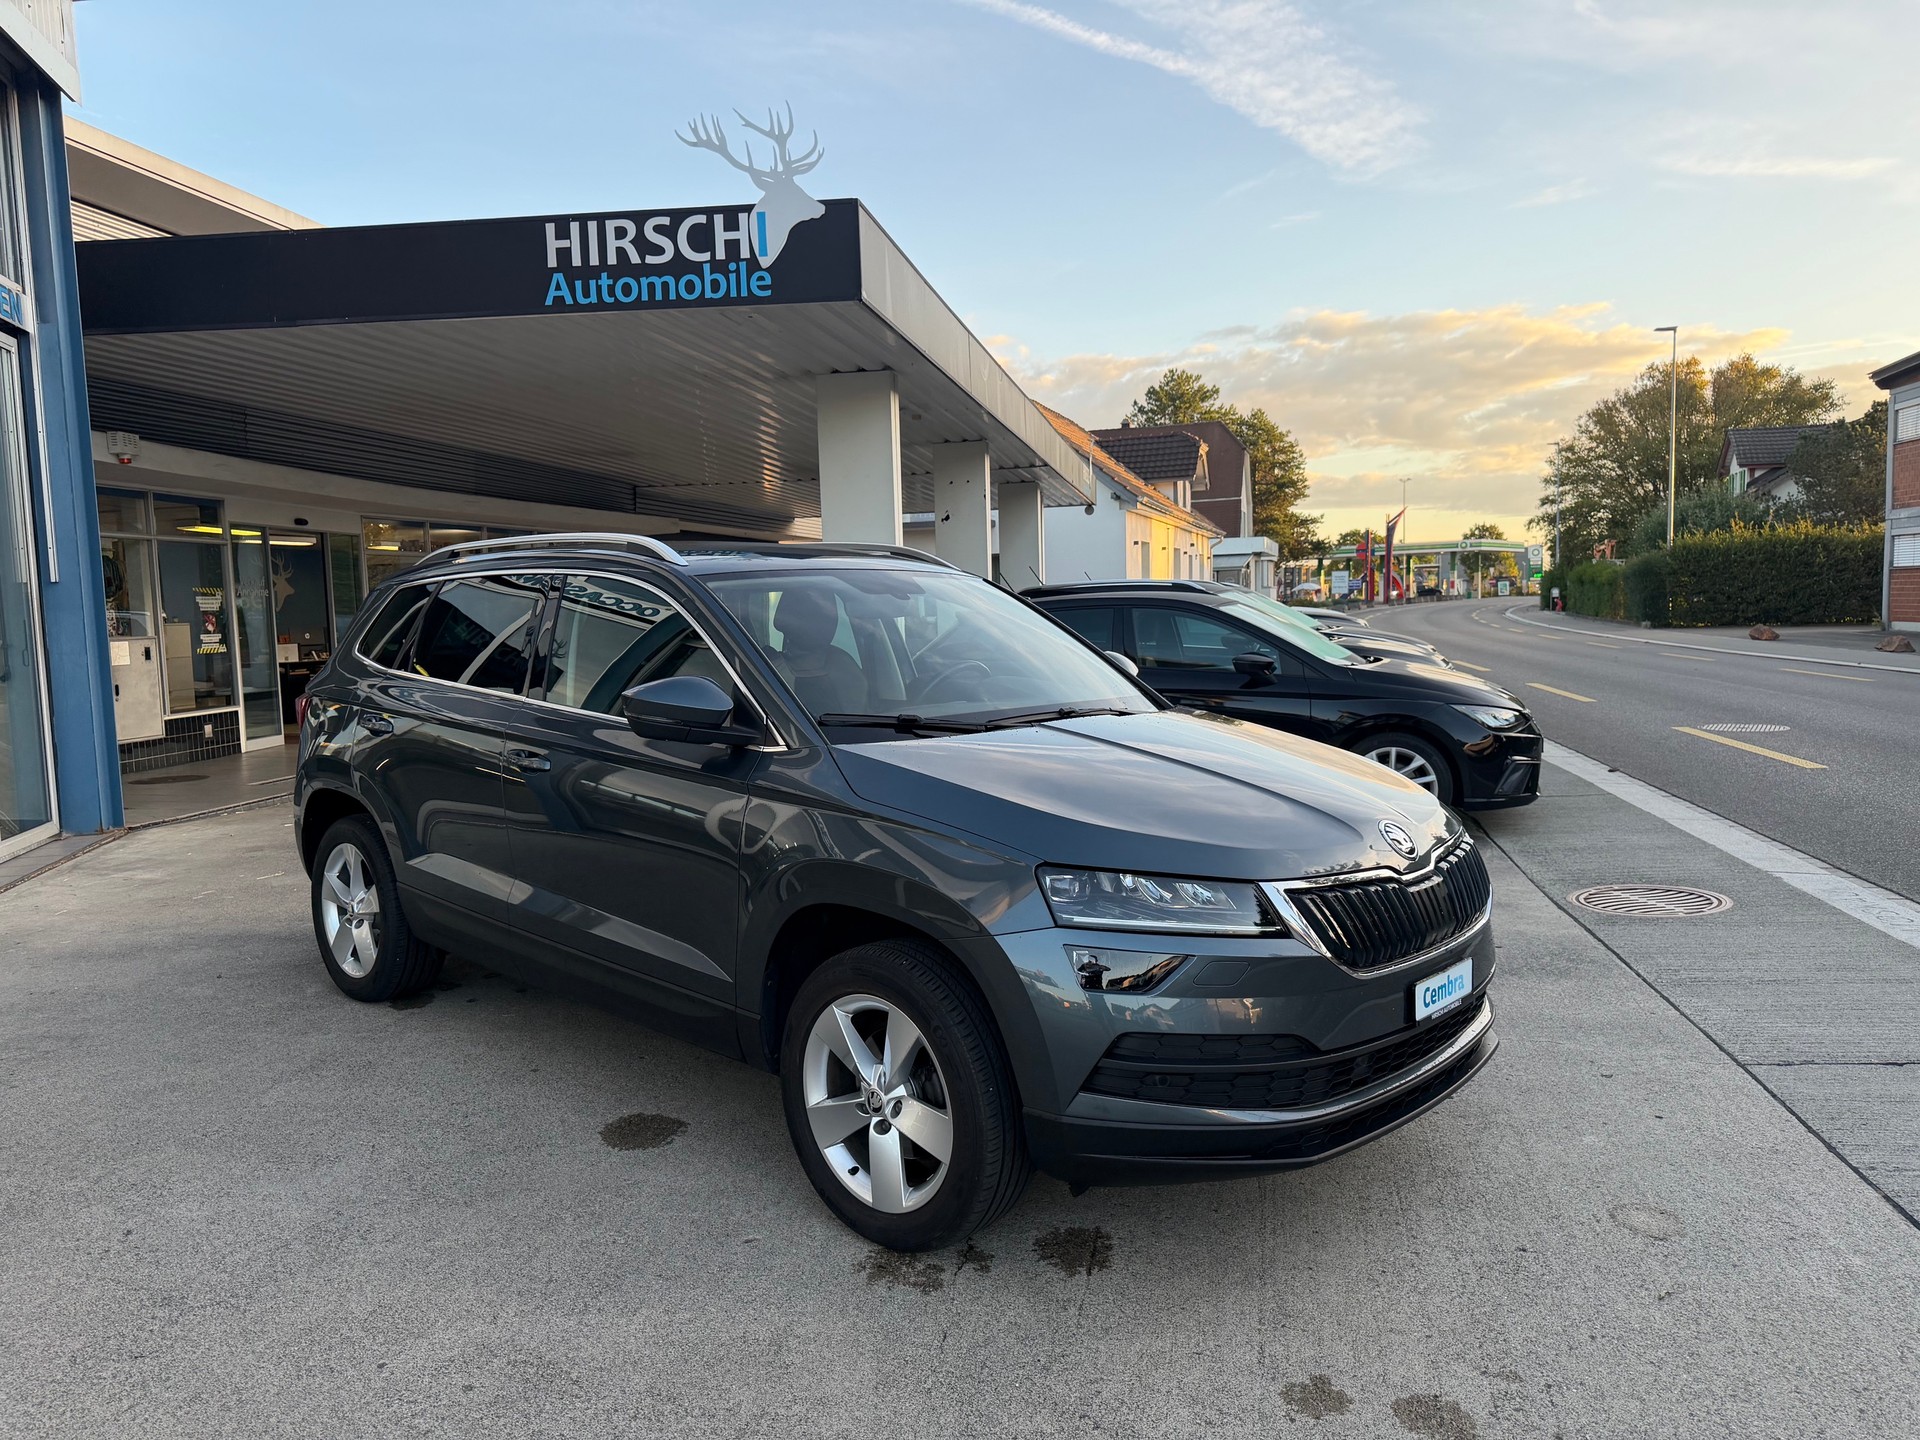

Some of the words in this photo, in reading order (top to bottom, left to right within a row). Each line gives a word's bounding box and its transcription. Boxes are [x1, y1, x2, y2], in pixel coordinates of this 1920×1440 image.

[545, 212, 768, 268] HIRSCHI
[545, 261, 772, 305] Automobile
[1423, 974, 1464, 1009] Cembra
